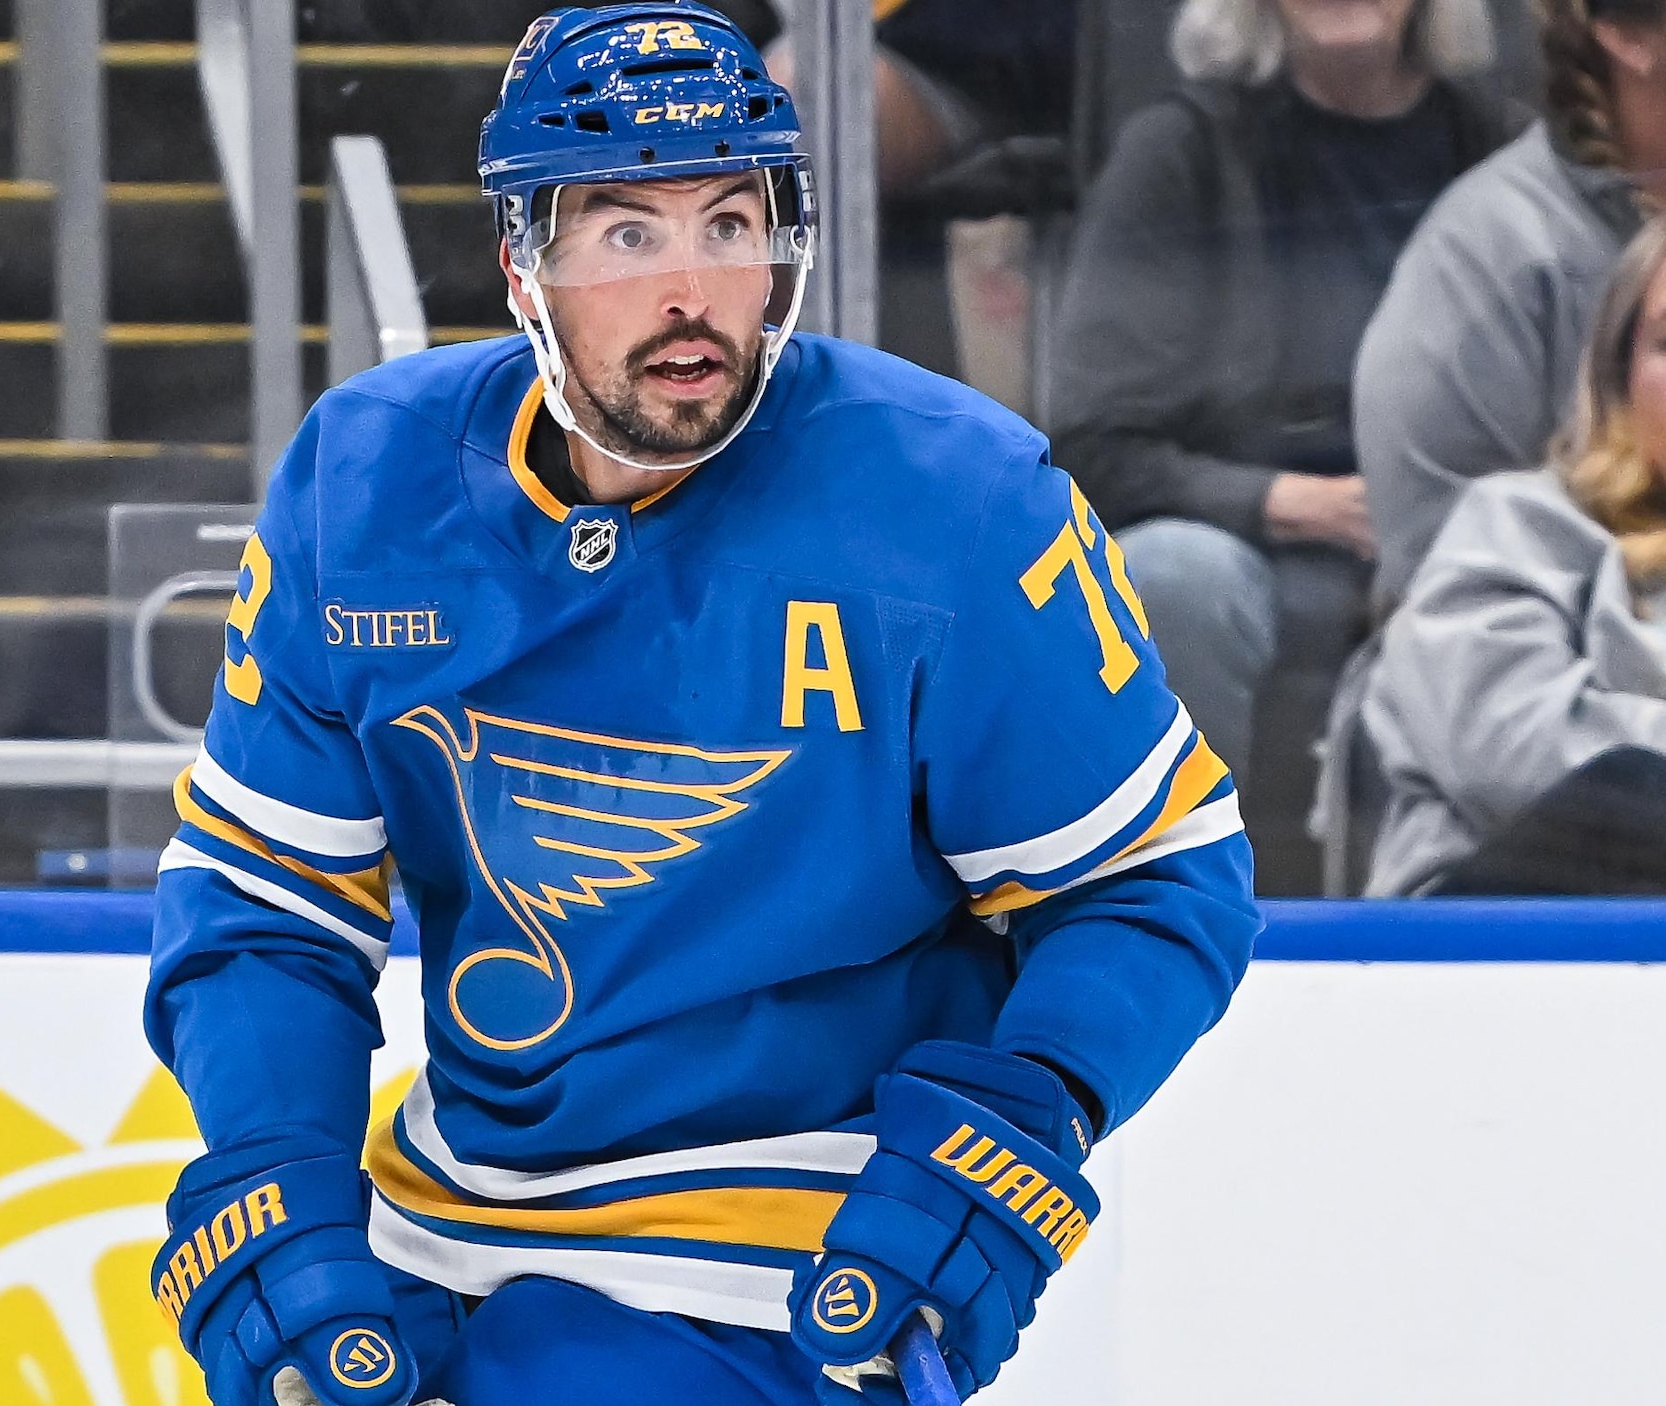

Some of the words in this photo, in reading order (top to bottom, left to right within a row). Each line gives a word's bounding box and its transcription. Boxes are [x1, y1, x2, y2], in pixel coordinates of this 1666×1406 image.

[624, 21, 706, 55] 72
[634, 102, 725, 124] CCM
[580, 532, 609, 560] NHL
[325, 604, 450, 648] STIFEL
[780, 600, 866, 732] A
[157, 1182, 289, 1322] RRIOR
